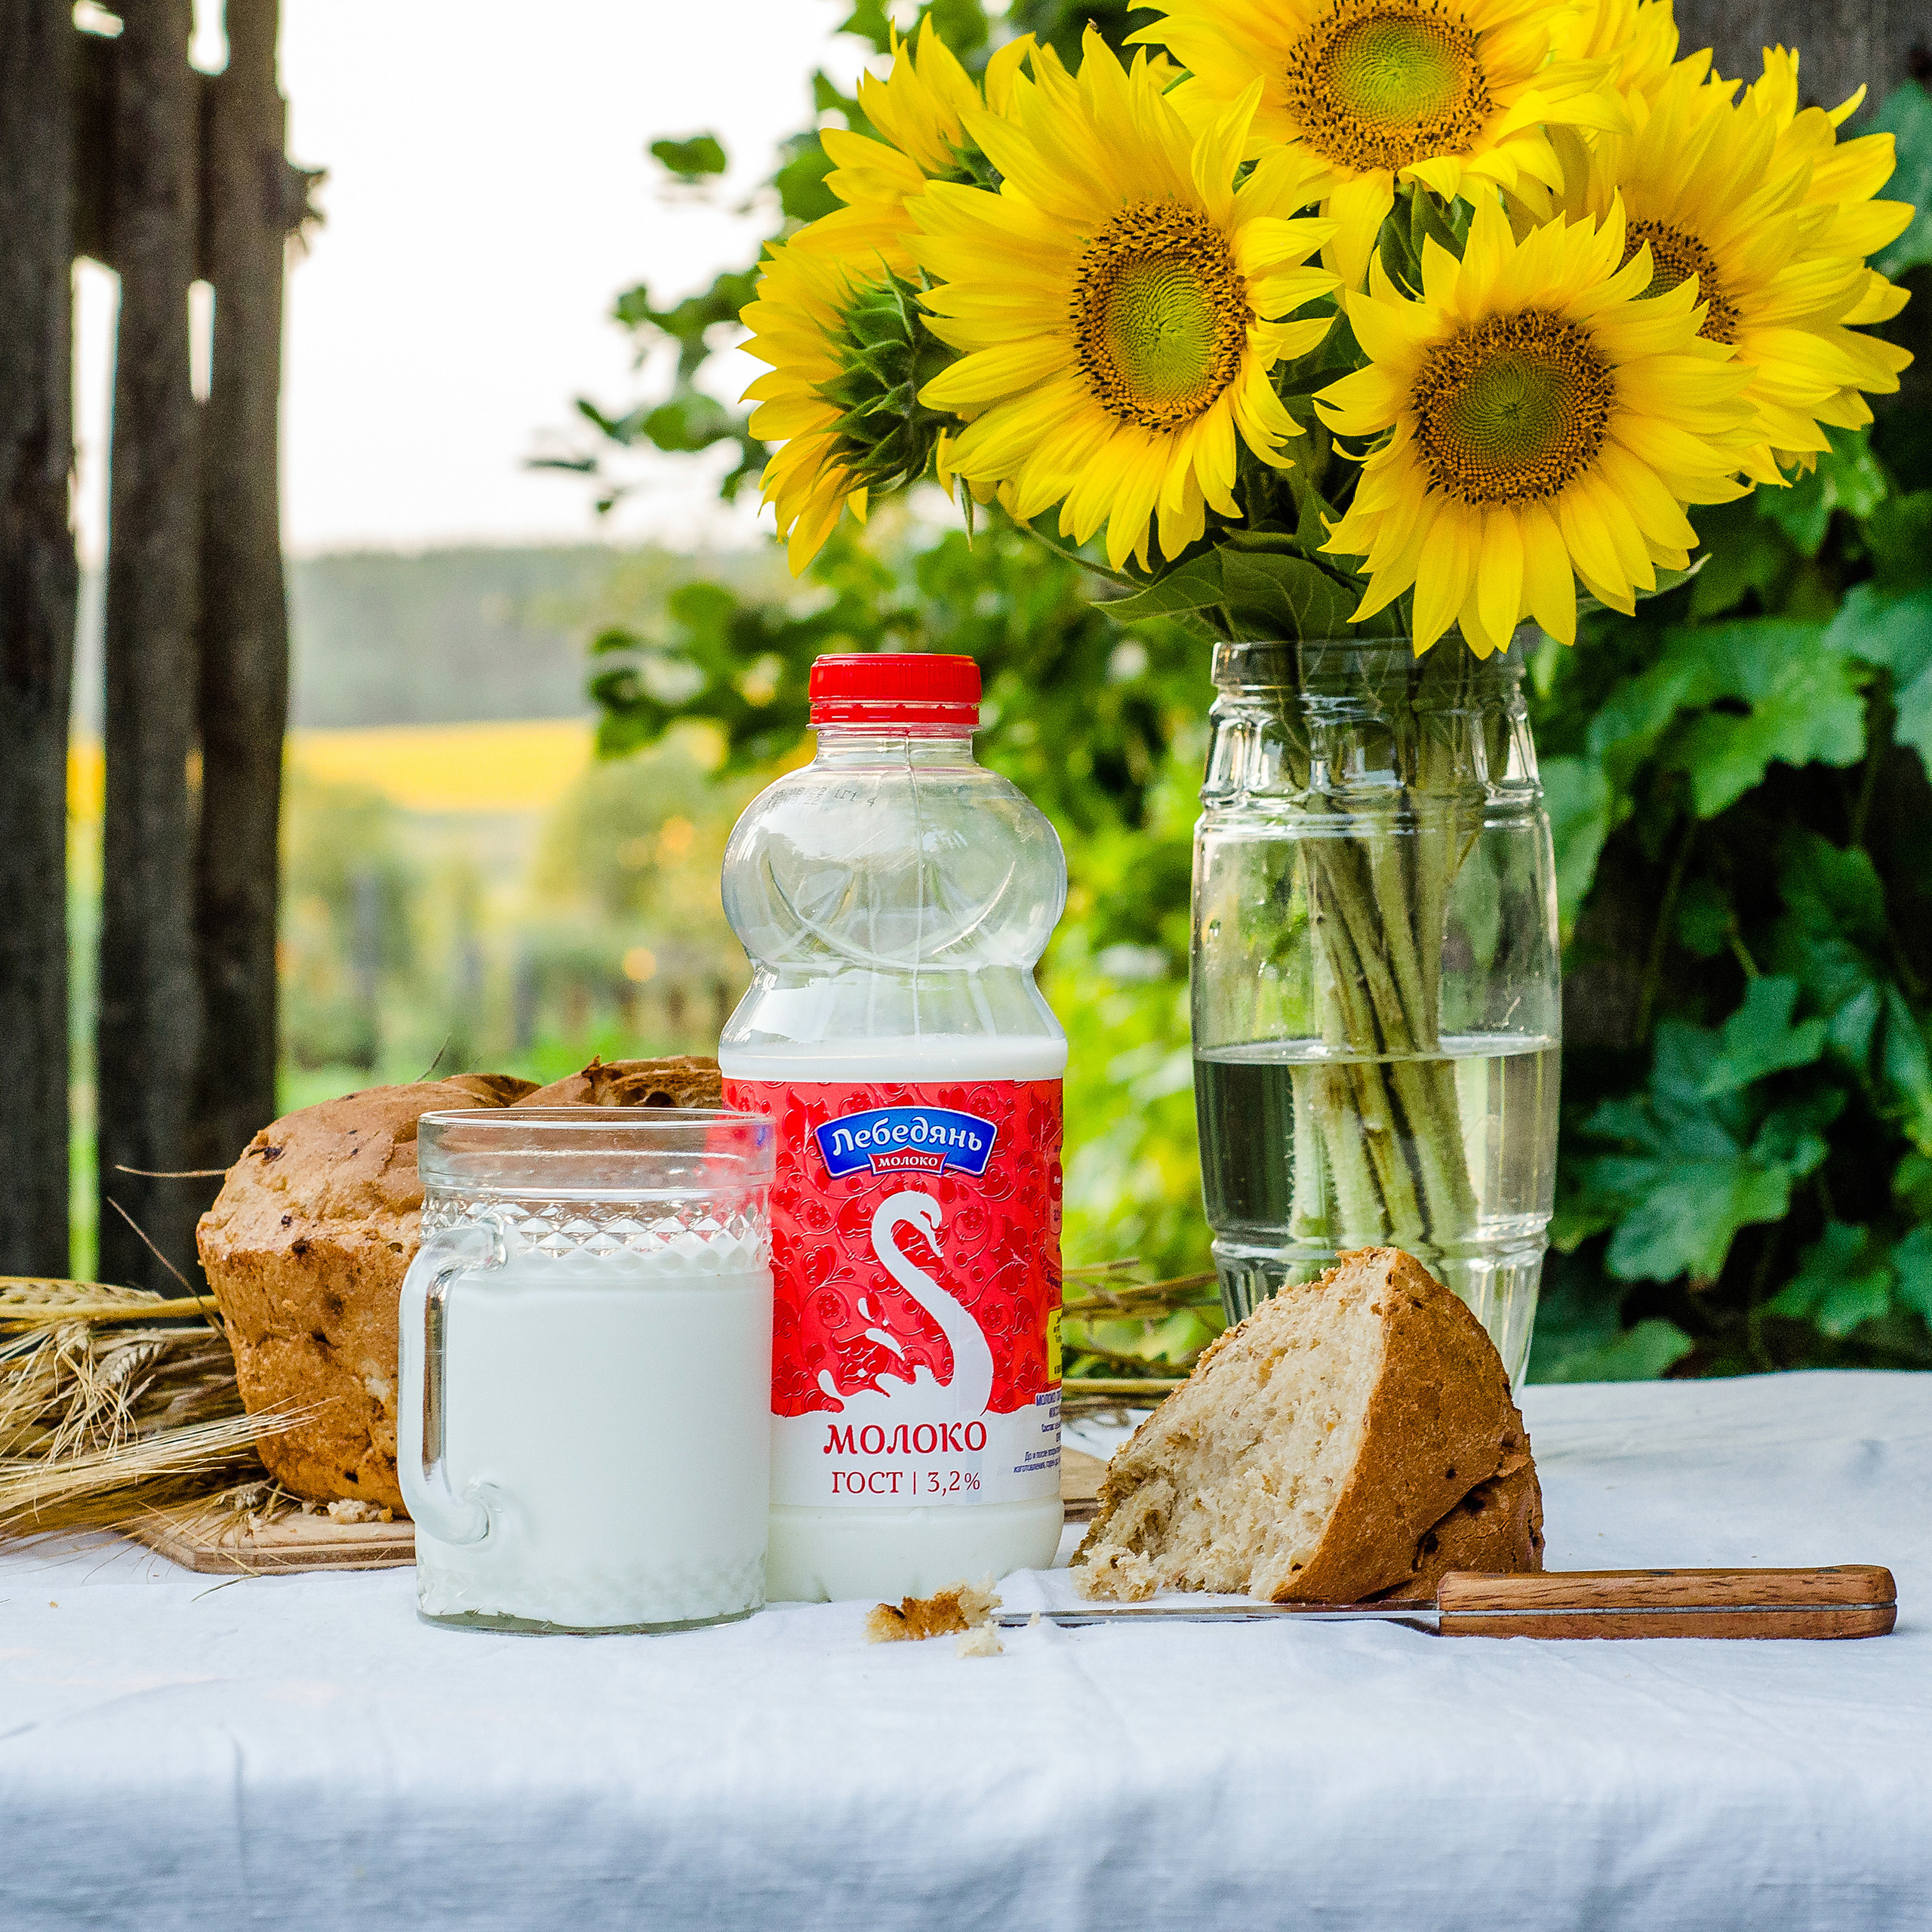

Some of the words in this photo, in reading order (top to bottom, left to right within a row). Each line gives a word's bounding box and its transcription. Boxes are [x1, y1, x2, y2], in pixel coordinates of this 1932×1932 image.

[832, 1116, 983, 1156] Лебедянь
[823, 1420, 987, 1455] МОЛОКО
[831, 1471, 903, 1494] ГОСТ
[927, 1470, 981, 1497] 3,2%
